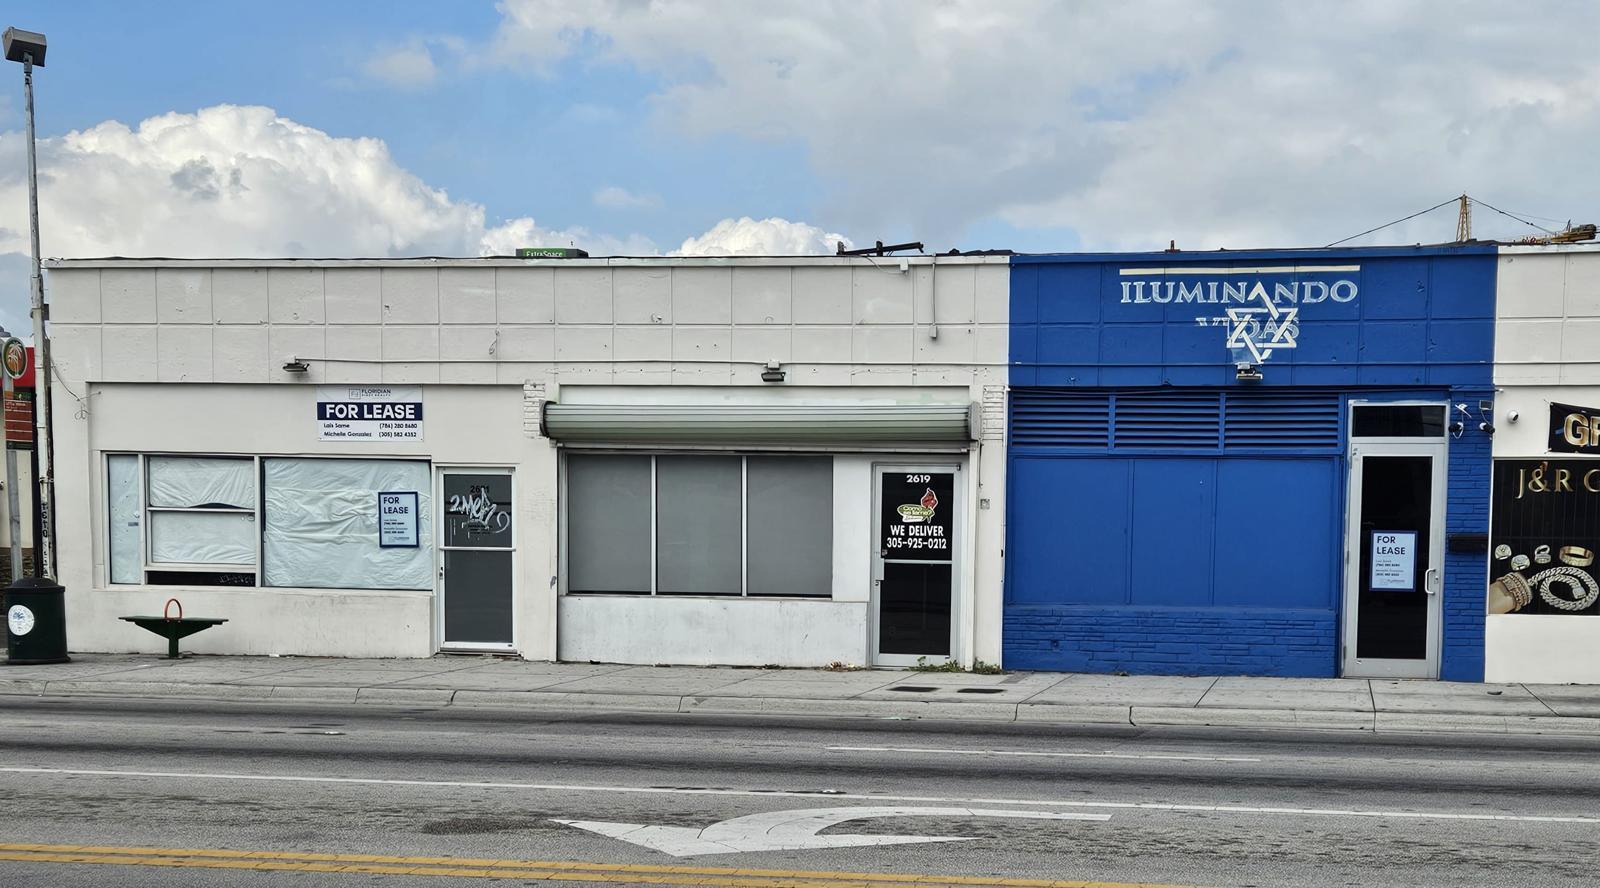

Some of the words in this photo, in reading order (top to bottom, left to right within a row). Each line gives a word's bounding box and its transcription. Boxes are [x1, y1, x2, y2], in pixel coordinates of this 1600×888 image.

[1120, 280, 1358, 304] ILUMINANDO
[325, 404, 359, 419] FOR
[363, 404, 415, 419] LEASE
[906, 474, 931, 483] 2619
[383, 496, 400, 504] FOR
[383, 506, 409, 514] LEASE
[890, 525, 905, 536] WE
[908, 525, 944, 537] DELIVER
[886, 537, 947, 549] 305-925-0212
[1376, 535, 1396, 544] FOR
[1376, 546, 1406, 555] LEASE
